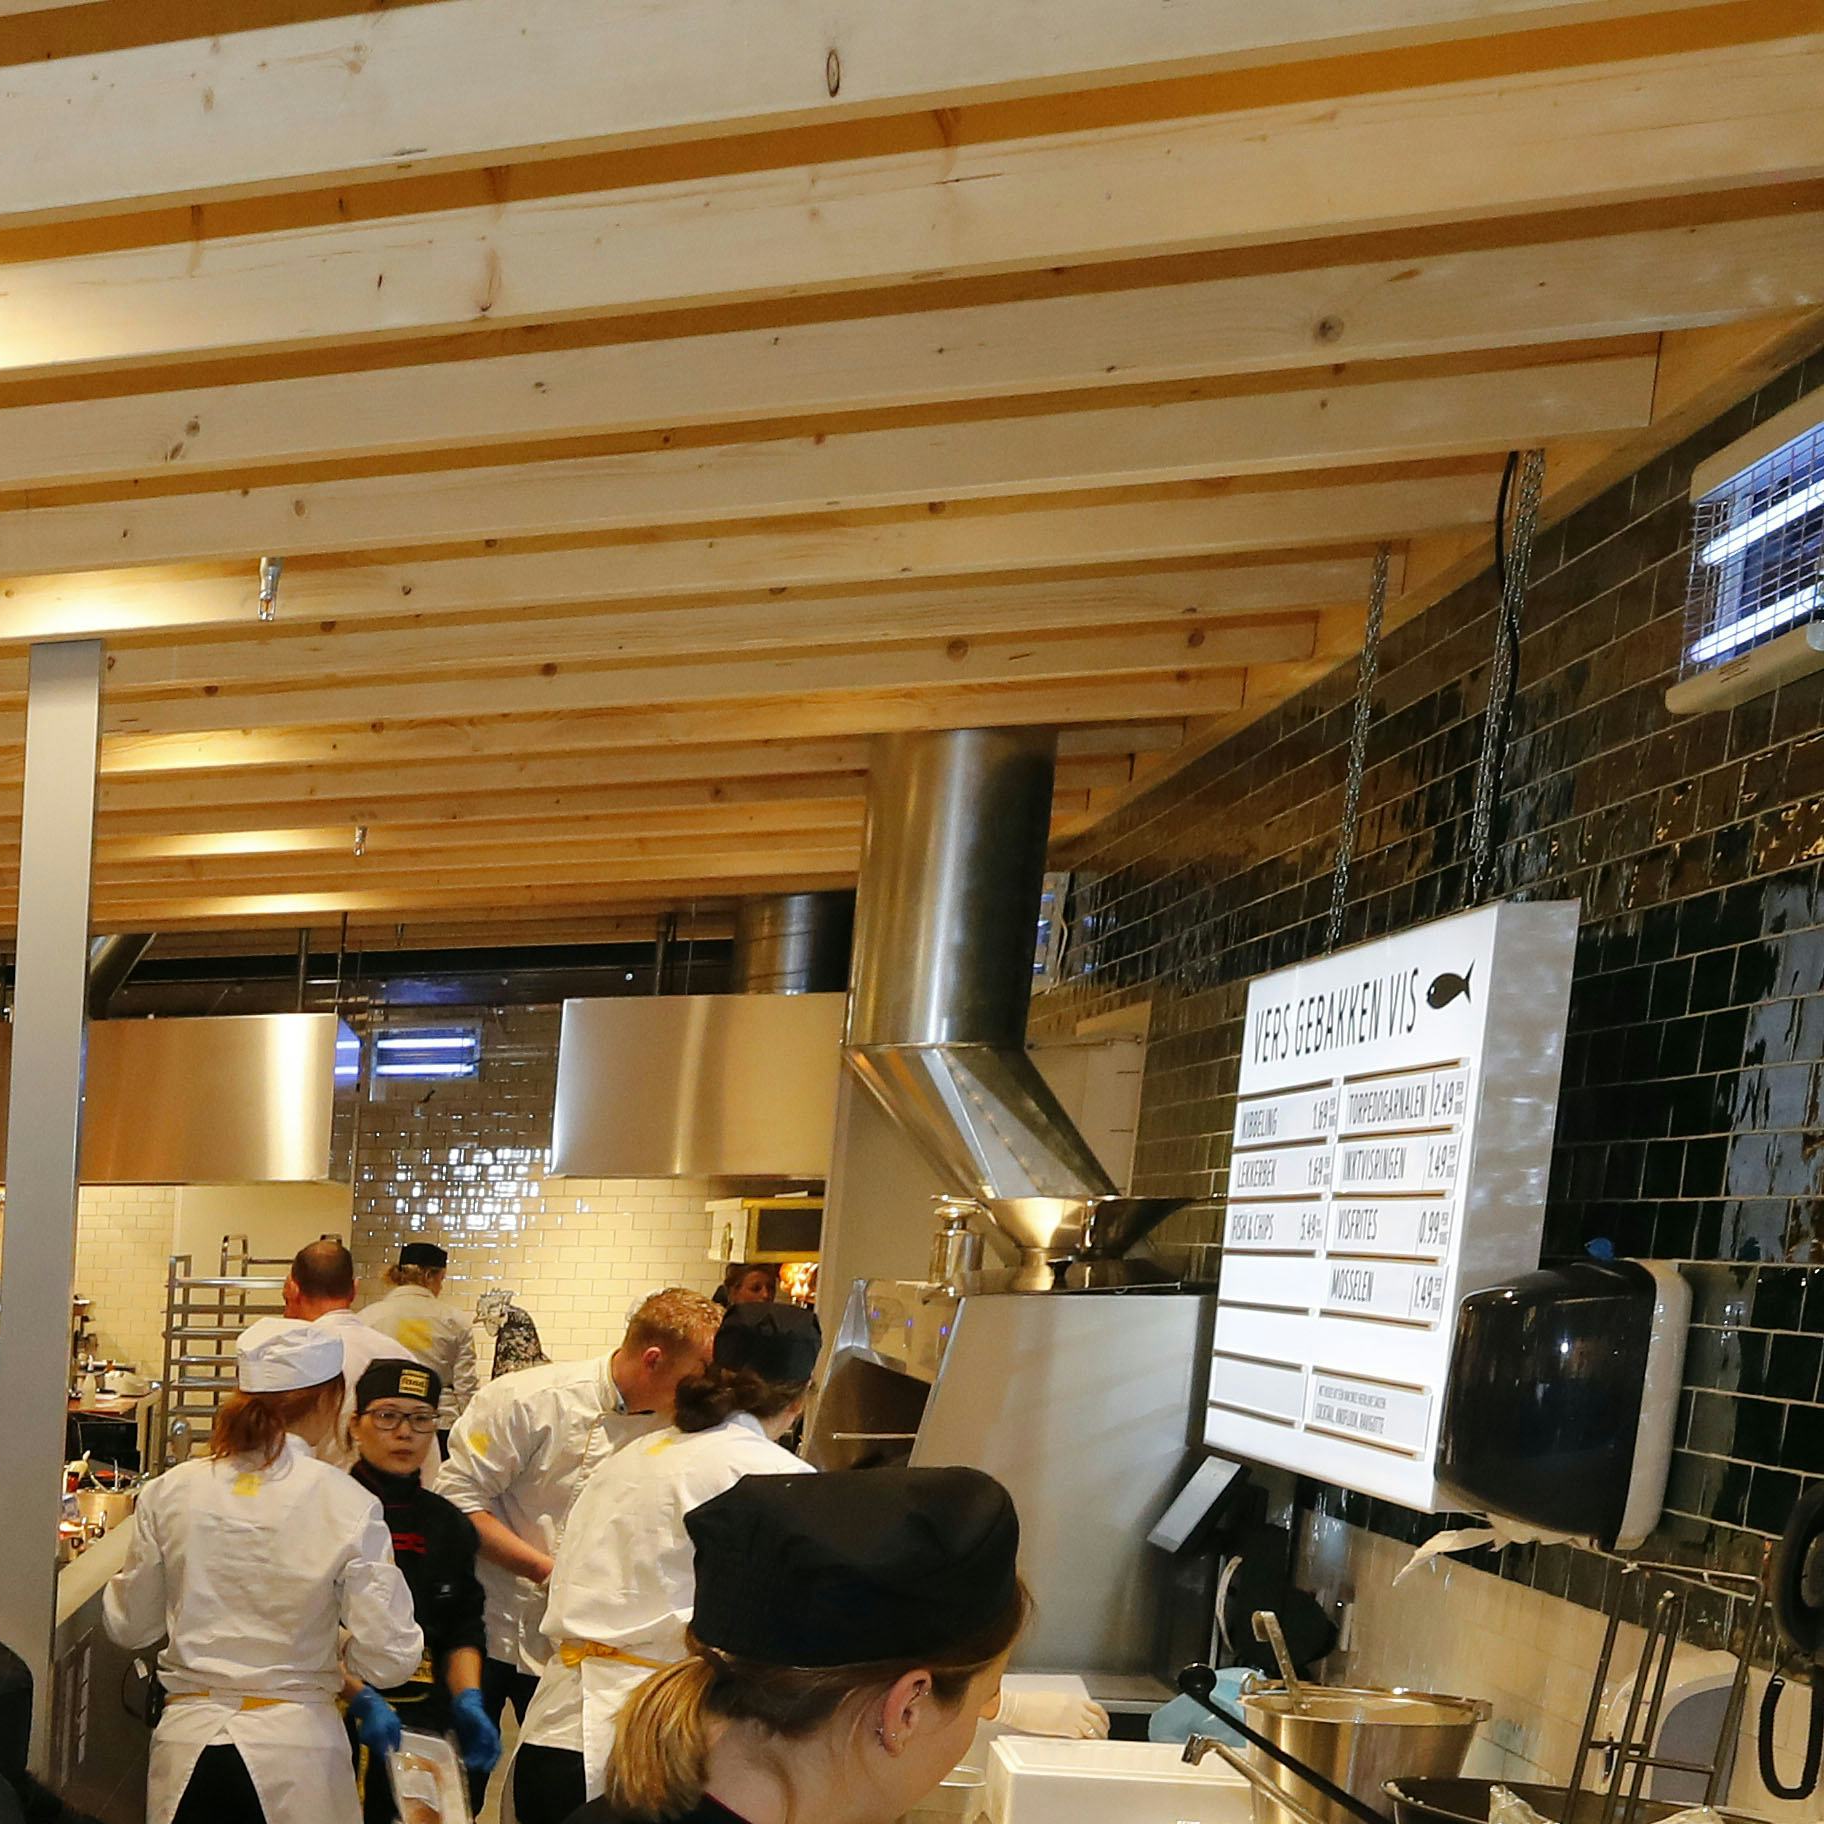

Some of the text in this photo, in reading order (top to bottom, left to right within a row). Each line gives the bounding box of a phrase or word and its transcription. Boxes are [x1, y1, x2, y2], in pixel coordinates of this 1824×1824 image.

[1253, 967, 1419, 1065] VERS GEBAKKEN VIS
[1432, 1081, 1454, 1117] 2.49
[1427, 1145, 1447, 1179] 1.49
[1337, 1208, 1441, 1246] VISFRITES 0.99
[1331, 1268, 1434, 1310] MOSSELEN 1.49
